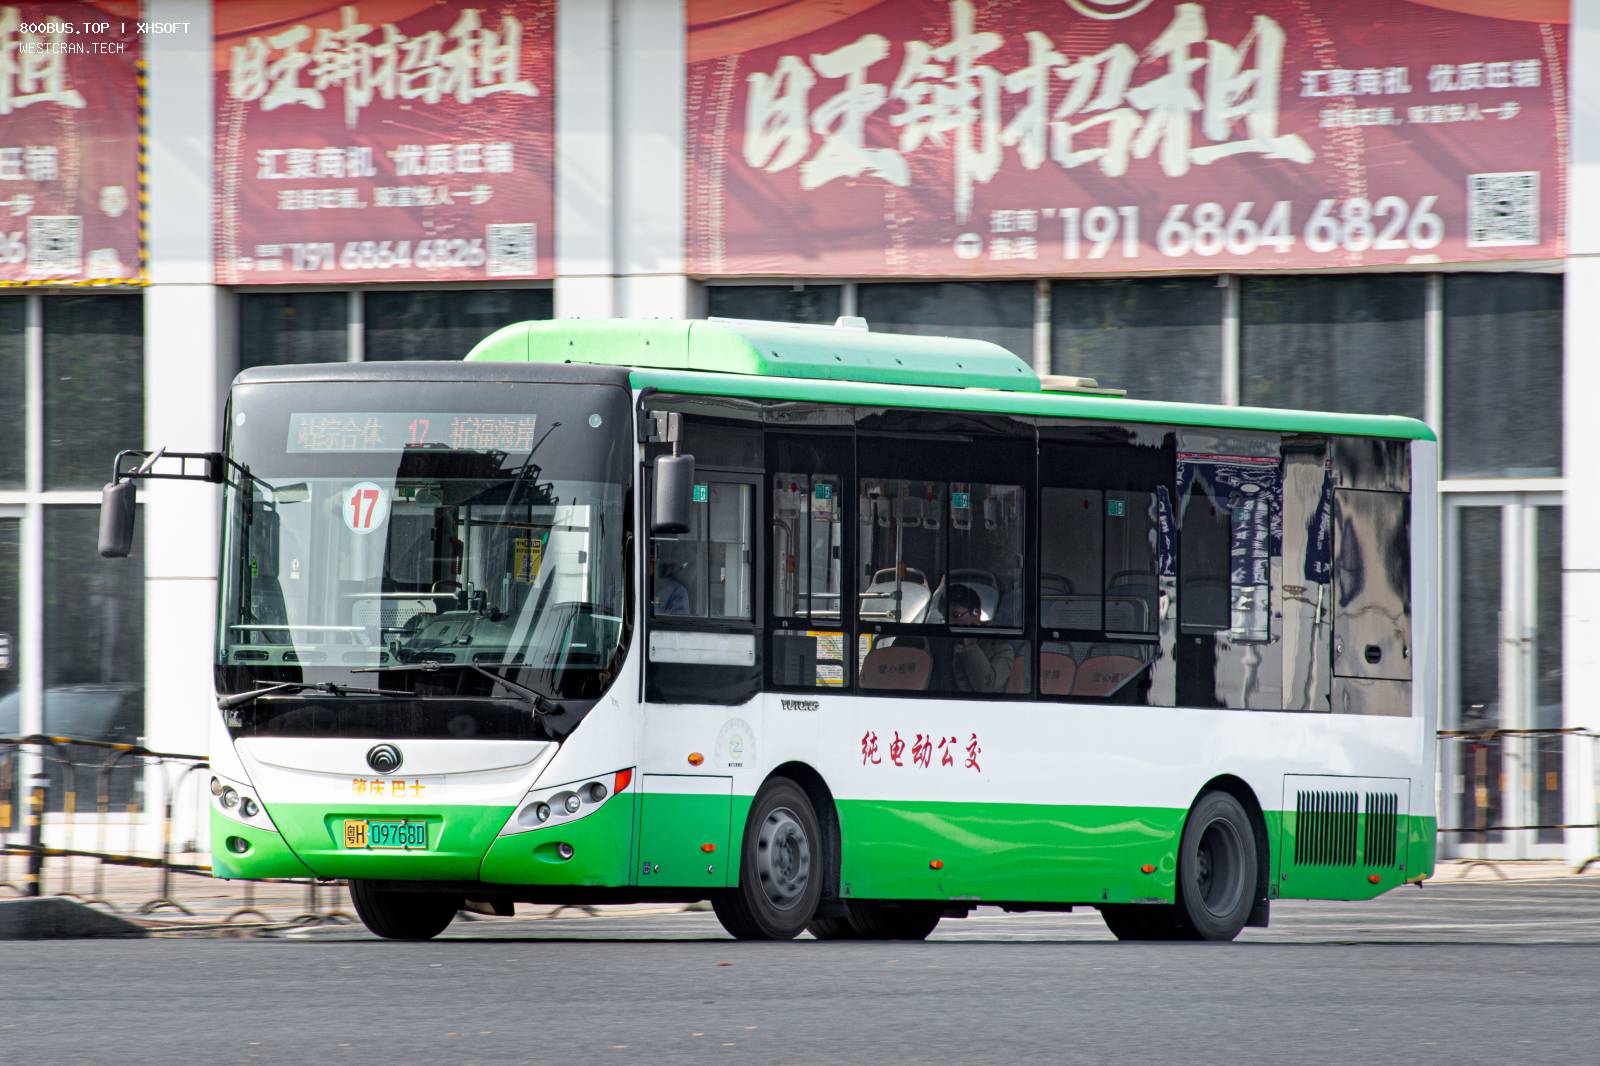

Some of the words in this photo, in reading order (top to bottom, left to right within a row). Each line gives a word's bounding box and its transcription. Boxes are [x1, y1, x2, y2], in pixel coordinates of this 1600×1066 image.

[228, 6, 539, 130] 旺铺招租
[1300, 67, 1412, 98] 汇聚商机
[1427, 59, 1542, 93] 优质旺铺
[743, 0, 1315, 222] 旺铺招租
[256, 147, 377, 179] 汇聚商机
[395, 142, 514, 176] 优质旺铺
[1059, 206, 1139, 260] 191
[1156, 200, 1296, 257] 6864
[1304, 195, 1445, 254] 6826
[291, 243, 335, 271] 191
[340, 240, 411, 269] 6864
[415, 238, 486, 268] 6826
[408, 418, 430, 448] 17
[351, 489, 379, 528] 17
[861, 730, 981, 773] 纯电动公交
[352, 778, 425, 799] 肇庆巴士
